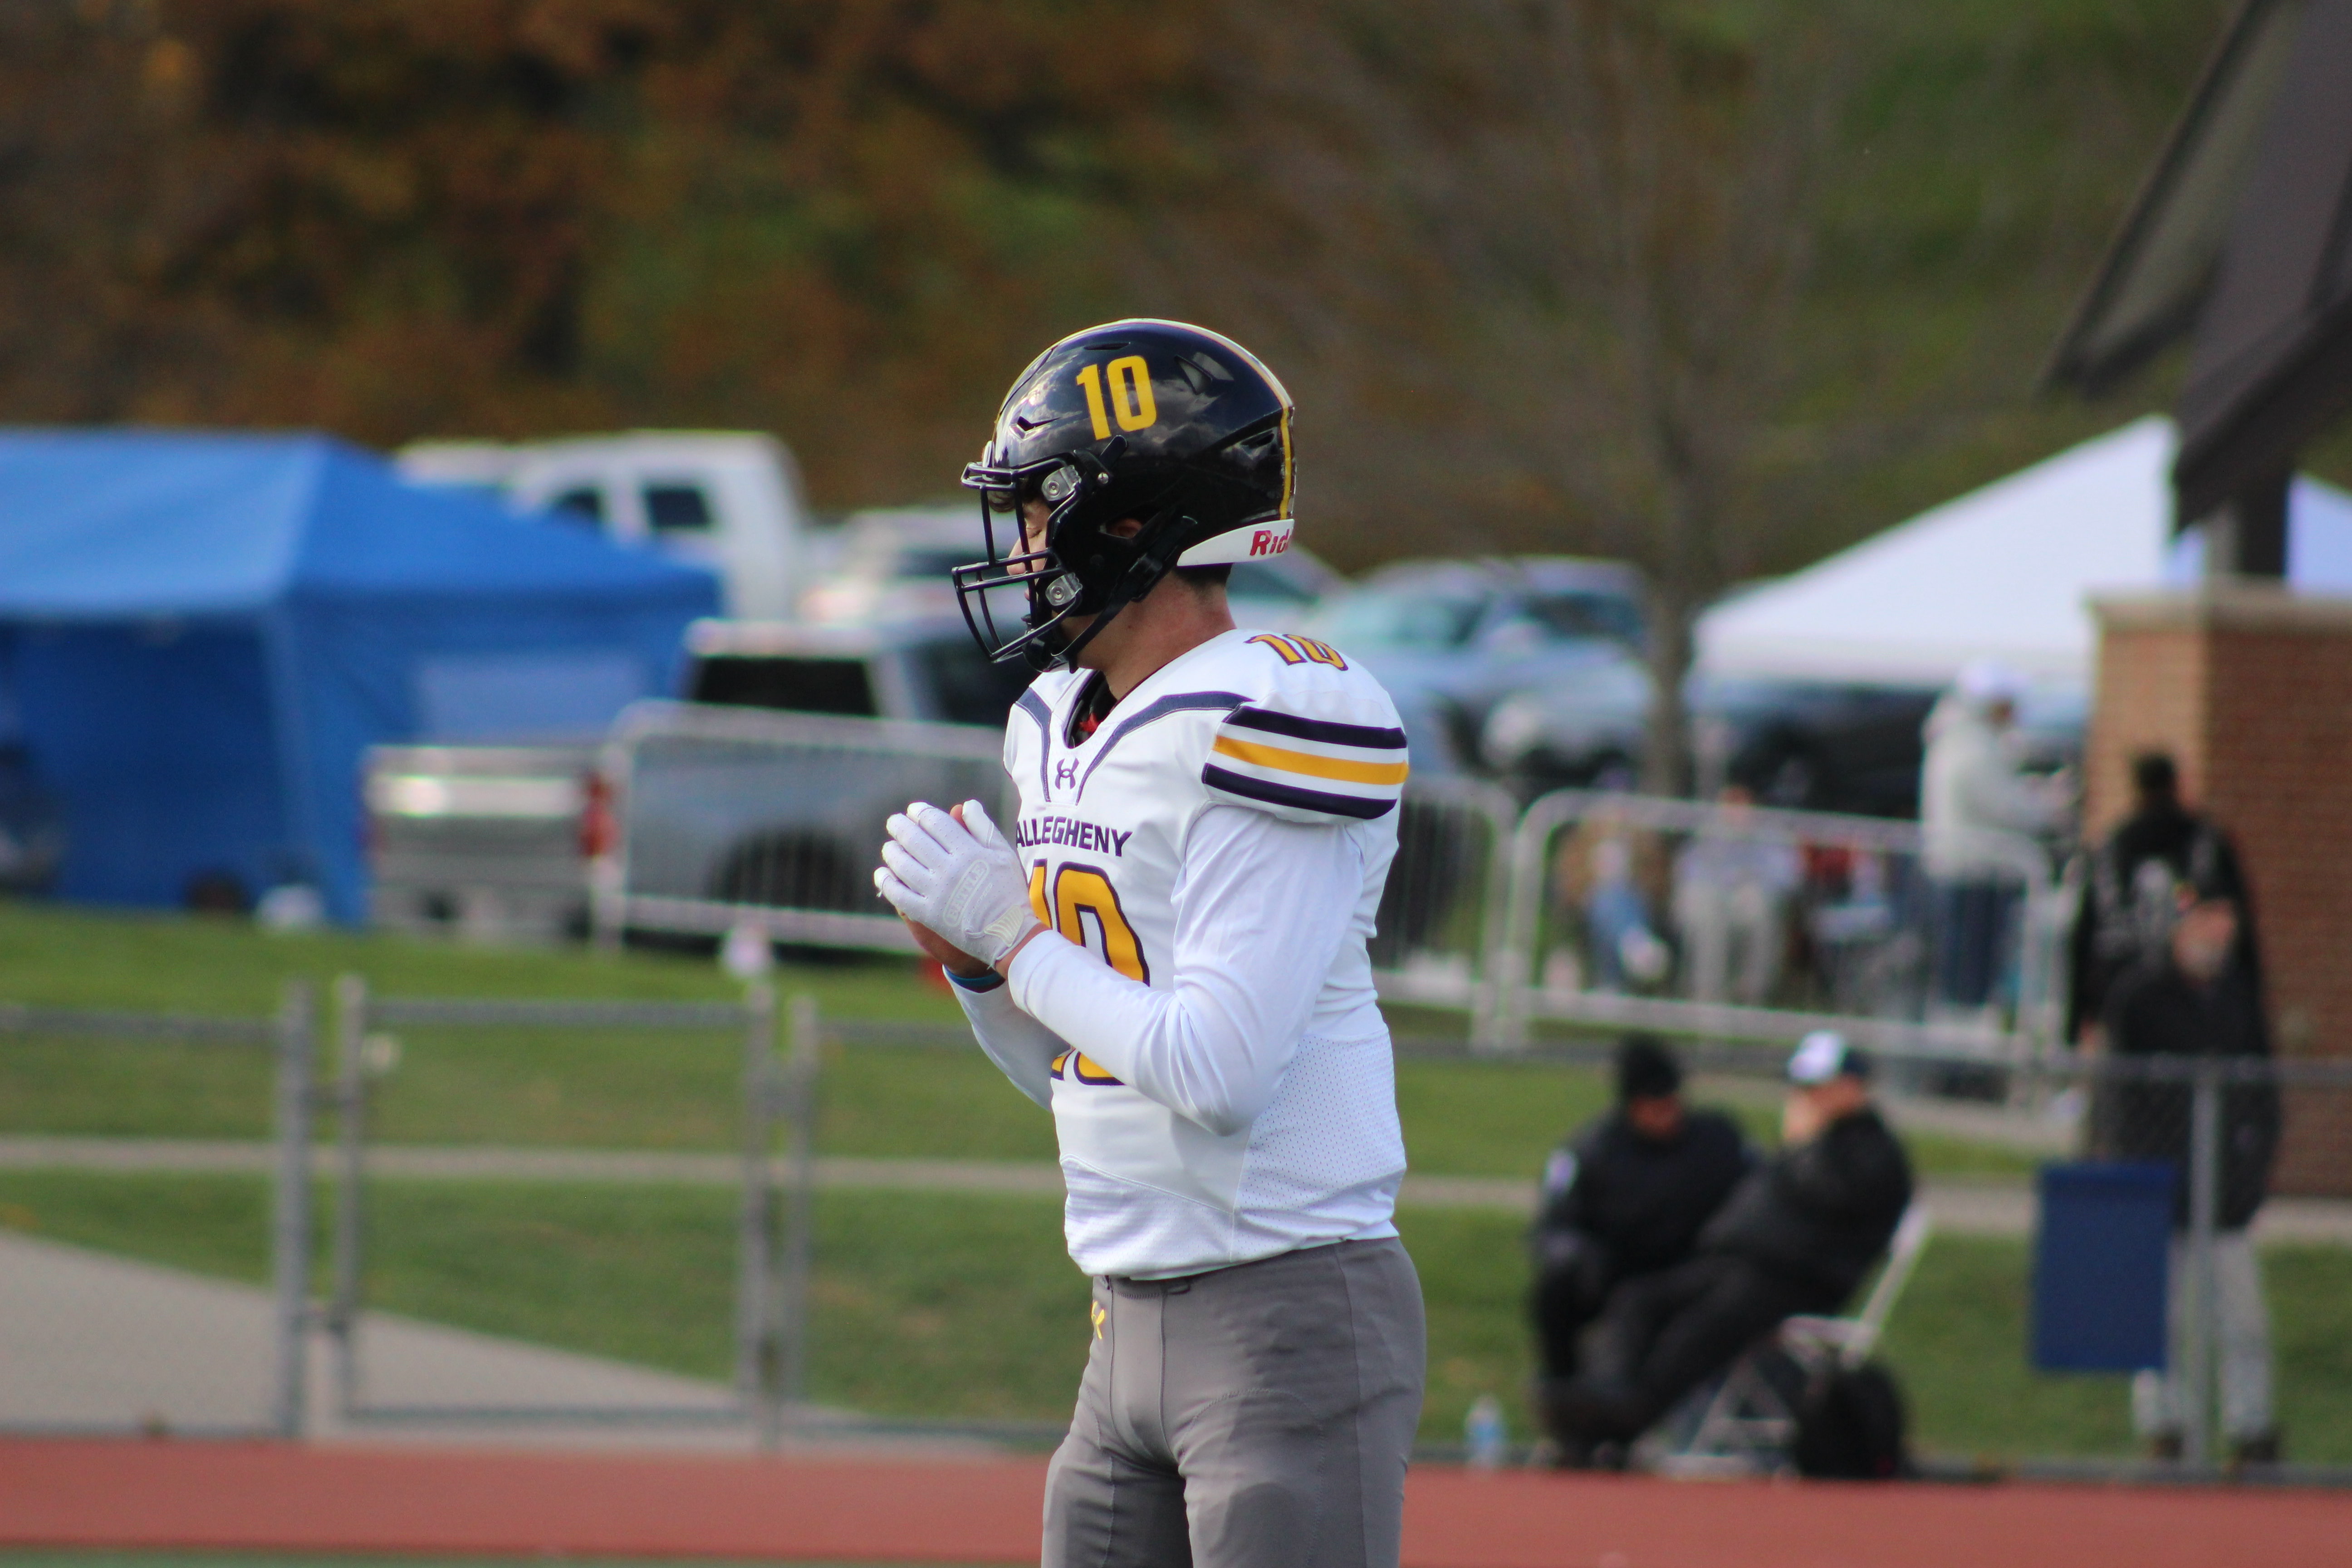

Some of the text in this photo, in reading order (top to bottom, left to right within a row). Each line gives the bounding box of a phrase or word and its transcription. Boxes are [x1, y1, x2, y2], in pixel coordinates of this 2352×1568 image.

[1076, 355, 1157, 441] 10
[1243, 633, 1349, 671] 10
[1016, 816, 1133, 857] ALLEGHENY
